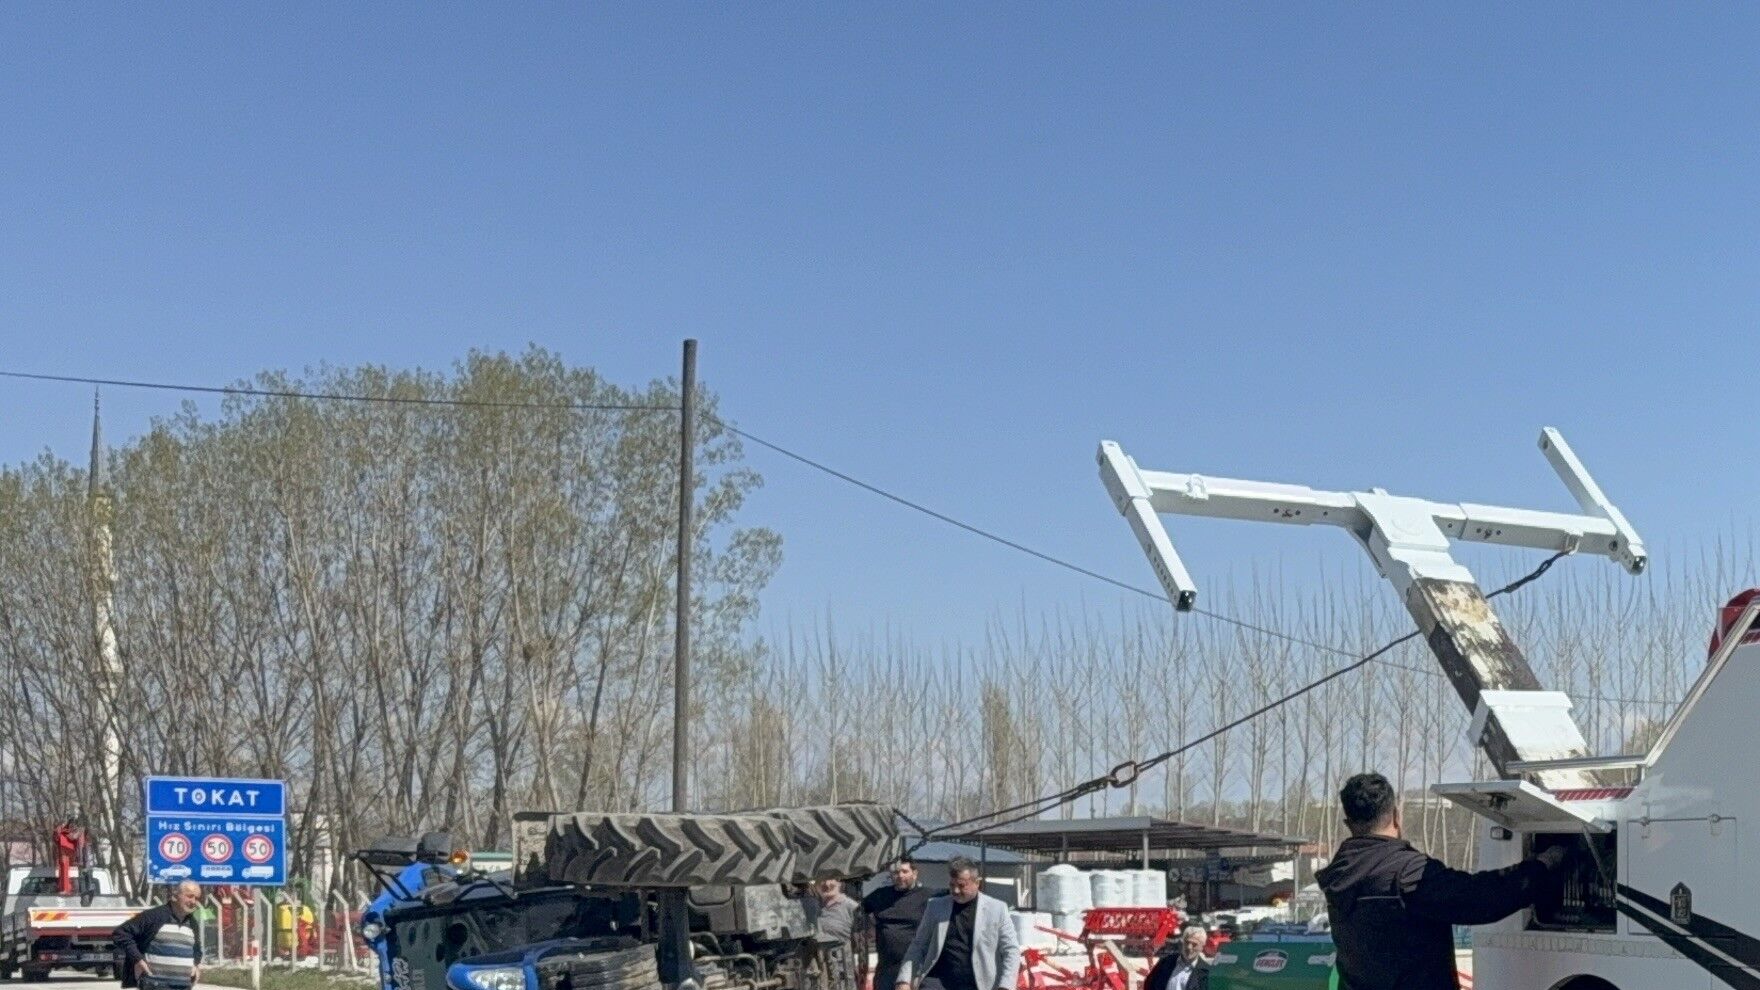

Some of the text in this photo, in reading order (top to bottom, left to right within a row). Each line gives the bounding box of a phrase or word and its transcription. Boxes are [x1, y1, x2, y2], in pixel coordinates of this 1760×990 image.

[174, 787, 260, 806] TOKAT
[158, 820, 180, 831] Hız
[184, 821, 221, 831] Sınırı
[167, 840, 186, 854] 70
[208, 841, 227, 855] 50
[249, 842, 268, 856] 50
